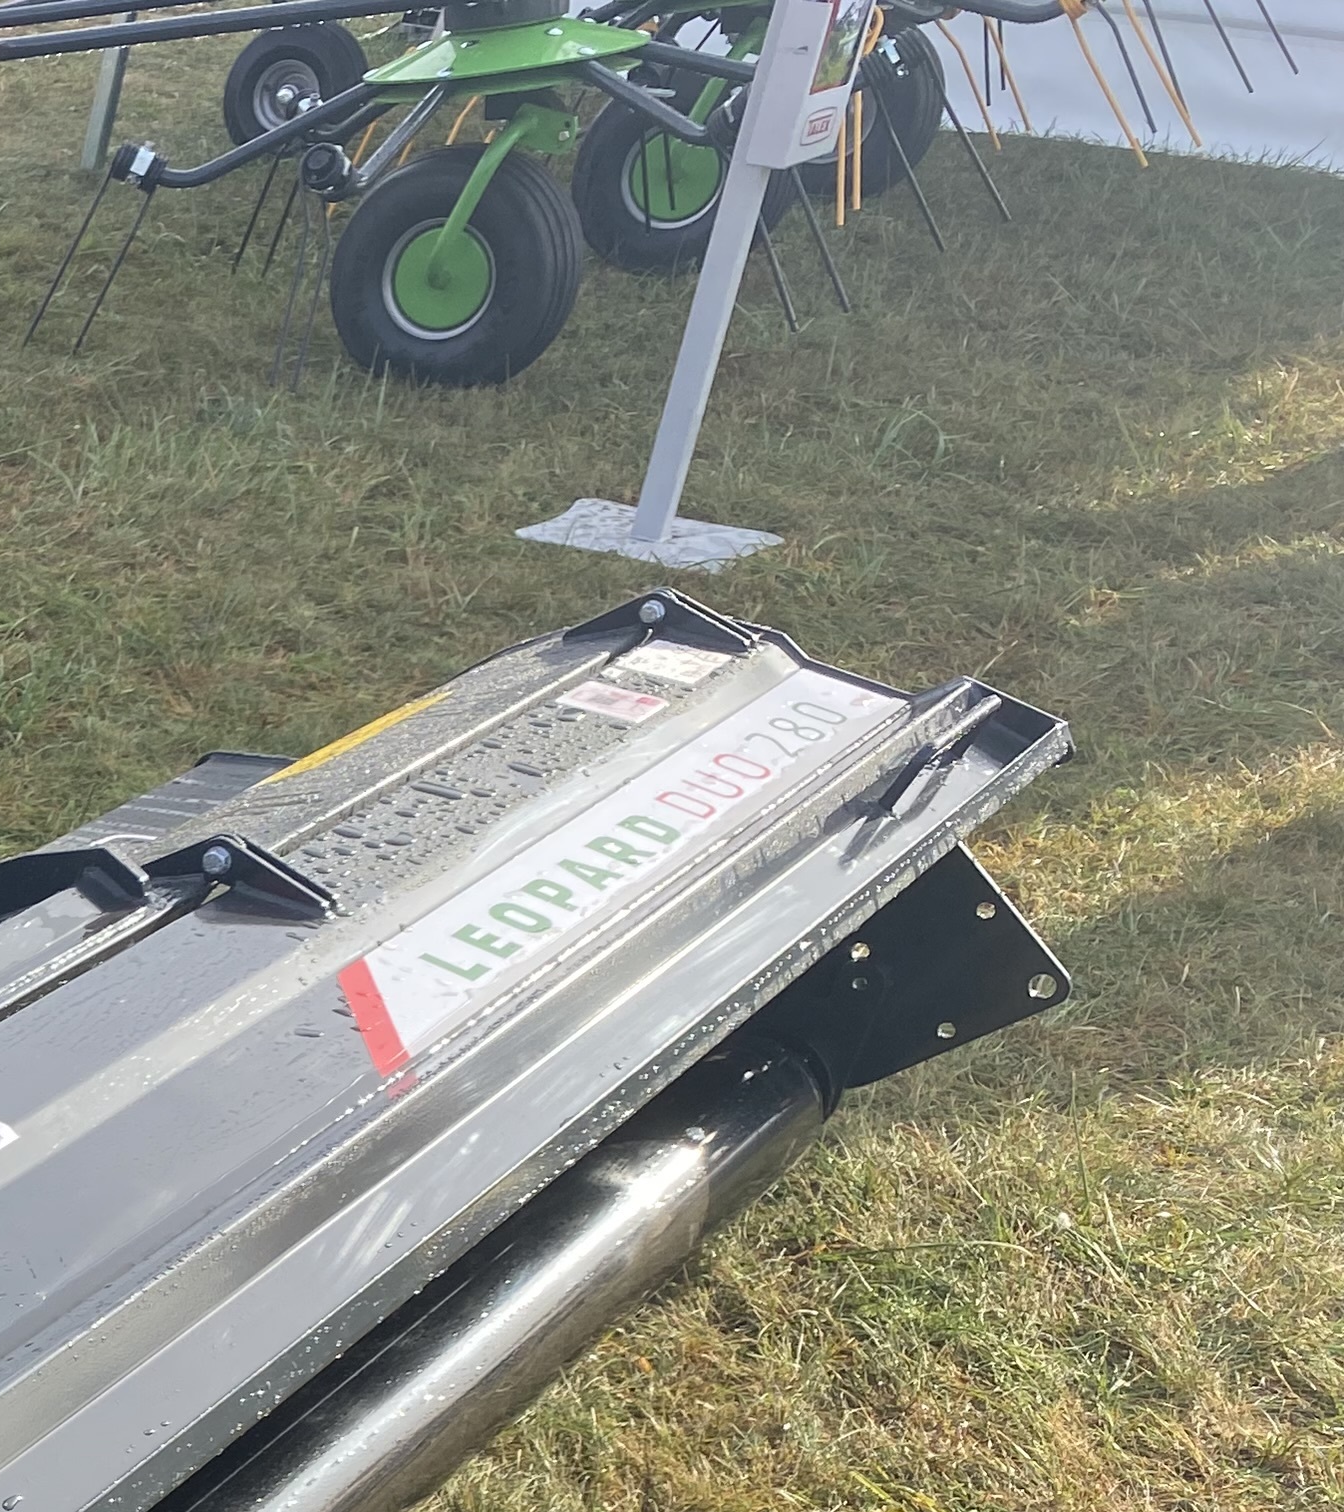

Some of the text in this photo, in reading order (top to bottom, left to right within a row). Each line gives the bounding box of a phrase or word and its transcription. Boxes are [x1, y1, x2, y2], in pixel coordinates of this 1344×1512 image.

[417, 815, 681, 981] LEOPARD
[655, 753, 771, 819] DUO
[745, 701, 847, 757] 280
